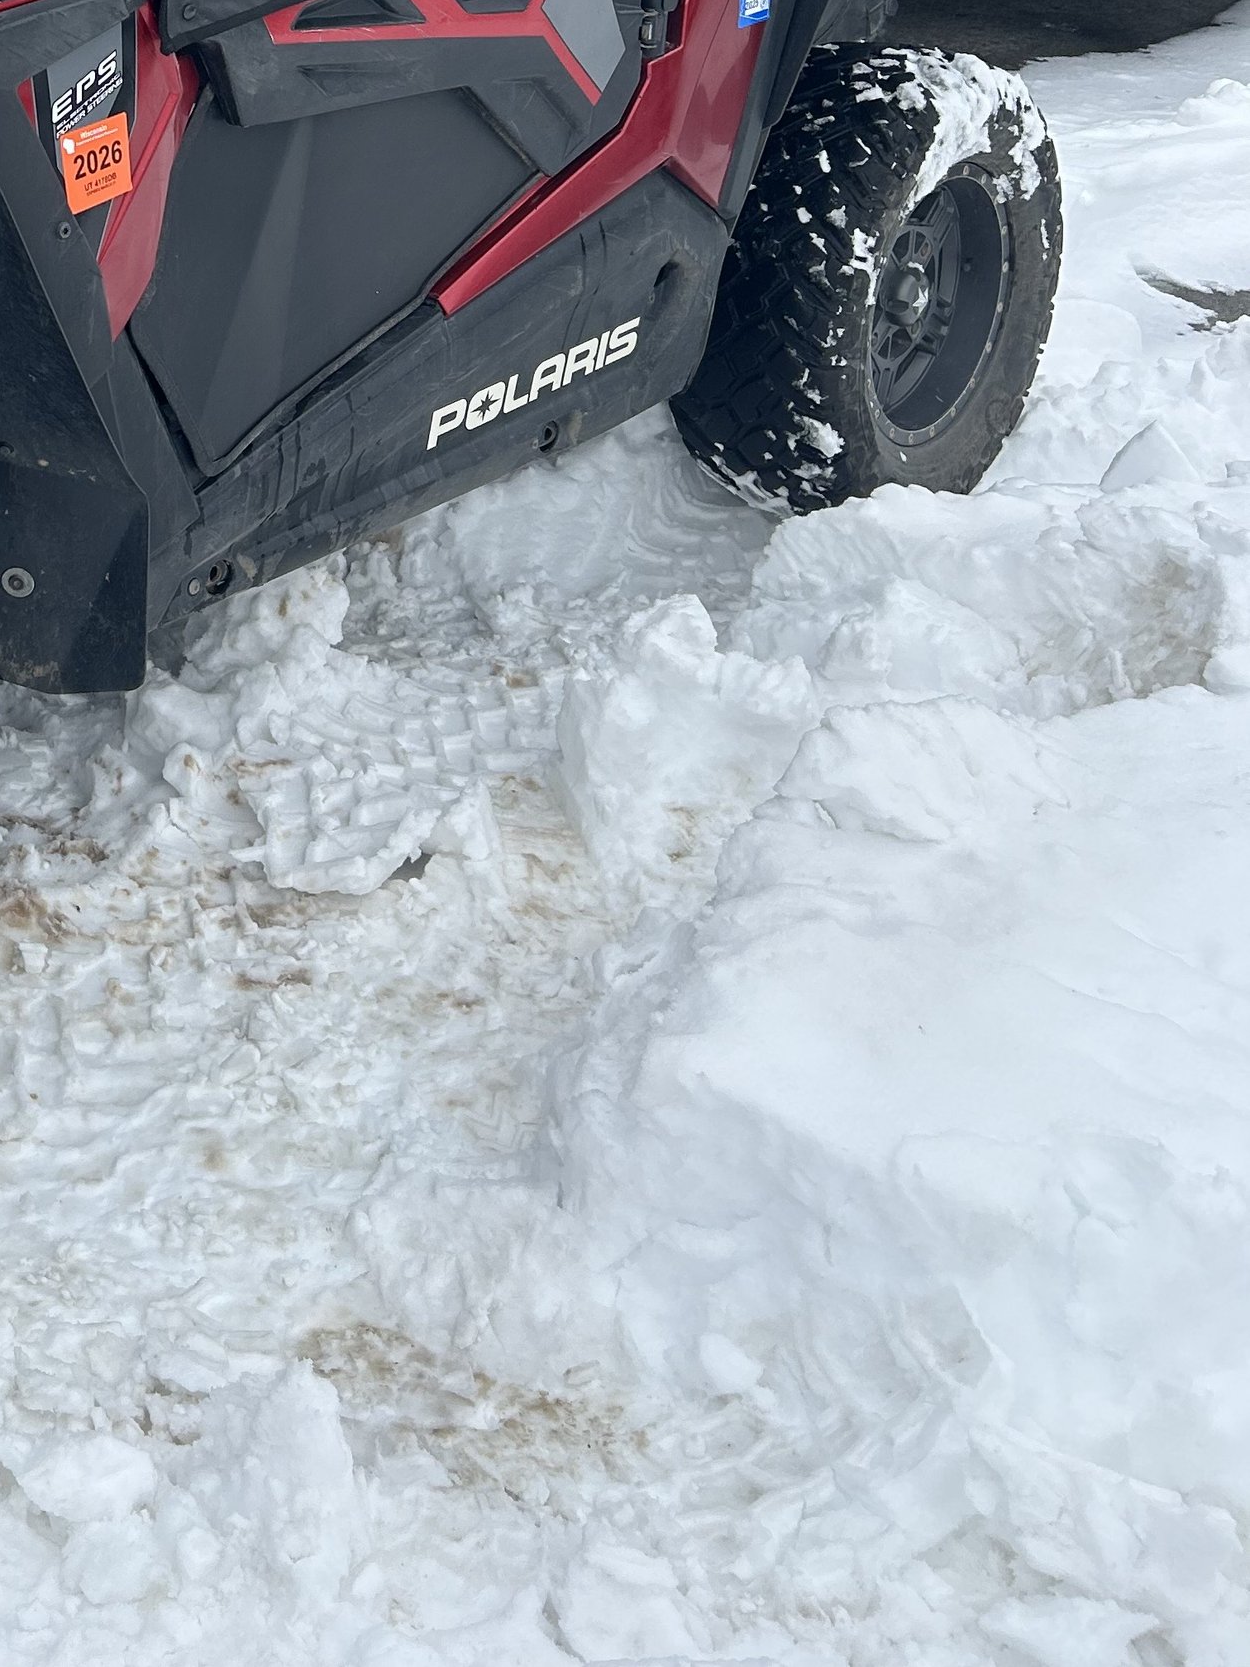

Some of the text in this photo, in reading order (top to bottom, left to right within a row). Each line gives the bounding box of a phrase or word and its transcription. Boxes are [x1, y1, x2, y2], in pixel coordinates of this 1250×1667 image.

[52, 49, 118, 124] EPS
[73, 139, 123, 181] 2026
[426, 316, 641, 451] POLARIS
